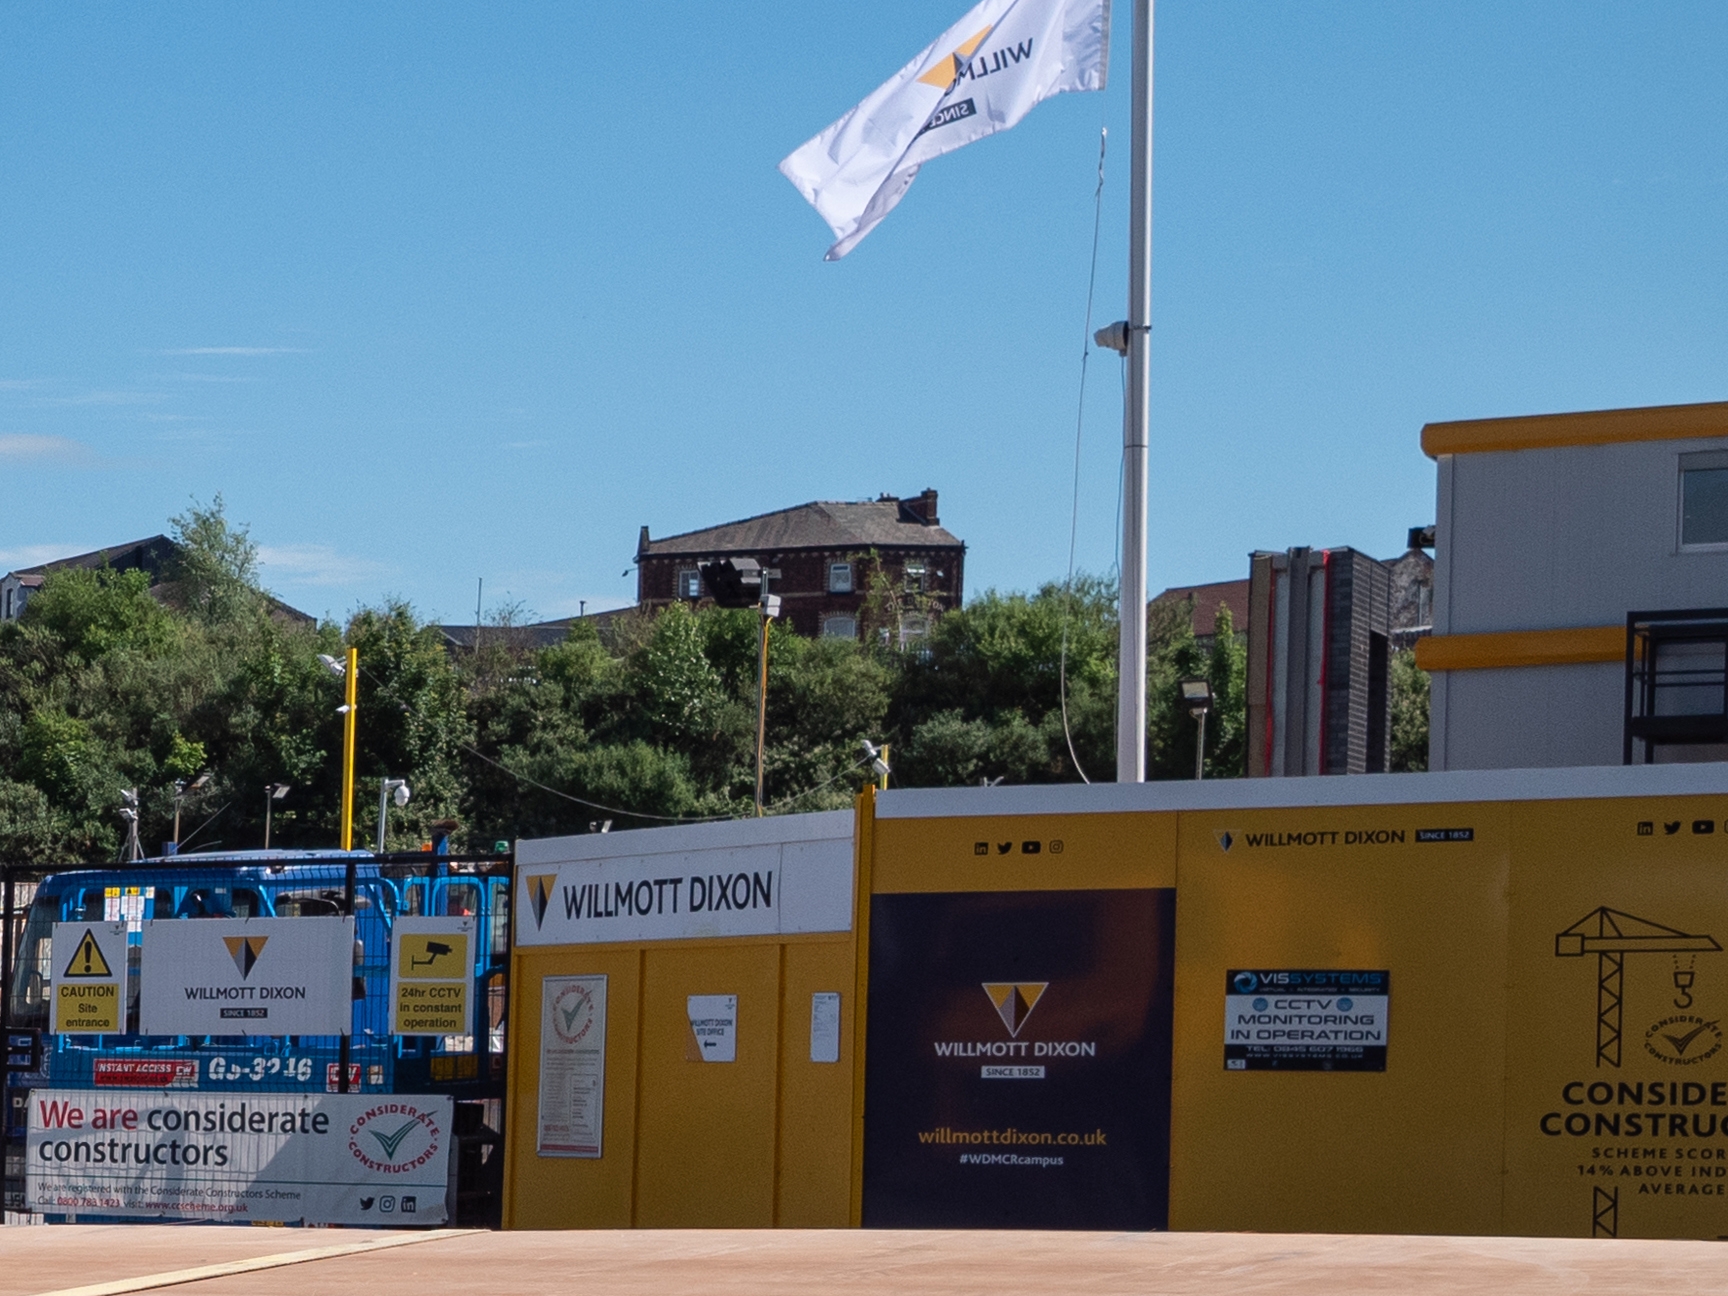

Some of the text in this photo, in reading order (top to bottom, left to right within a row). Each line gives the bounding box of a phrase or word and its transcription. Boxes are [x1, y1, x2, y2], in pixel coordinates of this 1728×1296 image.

[1245, 830, 1470, 847] WILLMOTT DIXON SINCE 1852
[563, 871, 773, 920] WILLMOTT DIXON
[1259, 972, 1382, 984] VISSYSTEMS
[60, 985, 115, 998] CAUTION
[184, 986, 306, 1000] WILLMOTT DIXON
[401, 987, 461, 998] 24hr CCTV
[78, 1003, 98, 1014] Site
[399, 1002, 462, 1013] in constant
[1274, 999, 1333, 1010] CCTV
[65, 1016, 110, 1028] entrance
[403, 1017, 457, 1029] operation
[1237, 1014, 1375, 1025] MONITORING
[1645, 1015, 1724, 1039] CONSIDERATE
[1230, 1029, 1381, 1041] IN OPERATION
[934, 1041, 1096, 1057] WILLMOTT DIXON
[1644, 1042, 1723, 1066] CONSTRUCTORS
[985, 1068, 1041, 1077] SINCE 1852
[1562, 1081, 1728, 1106] CONSIDE
[39, 1100, 330, 1134] We are considerate
[349, 1104, 440, 1137] CONSIDERATE
[918, 1127, 1108, 1145] willmottdixon.co.uk
[39, 1137, 229, 1167] constructors
[348, 1141, 439, 1174] CONSTRUCTORS
[1592, 1147, 1726, 1160] SCHEME SCOR
[959, 1154, 1064, 1168] #WDMCRcampus
[1577, 1164, 1728, 1178] 14% ABOVE IND
[38, 1182, 301, 1200] We are registered with the Considerate Constructors Scheme
[1638, 1182, 1725, 1196] AVERAGE
[145, 1200, 248, 1214] www.ccscheme.org.uk
